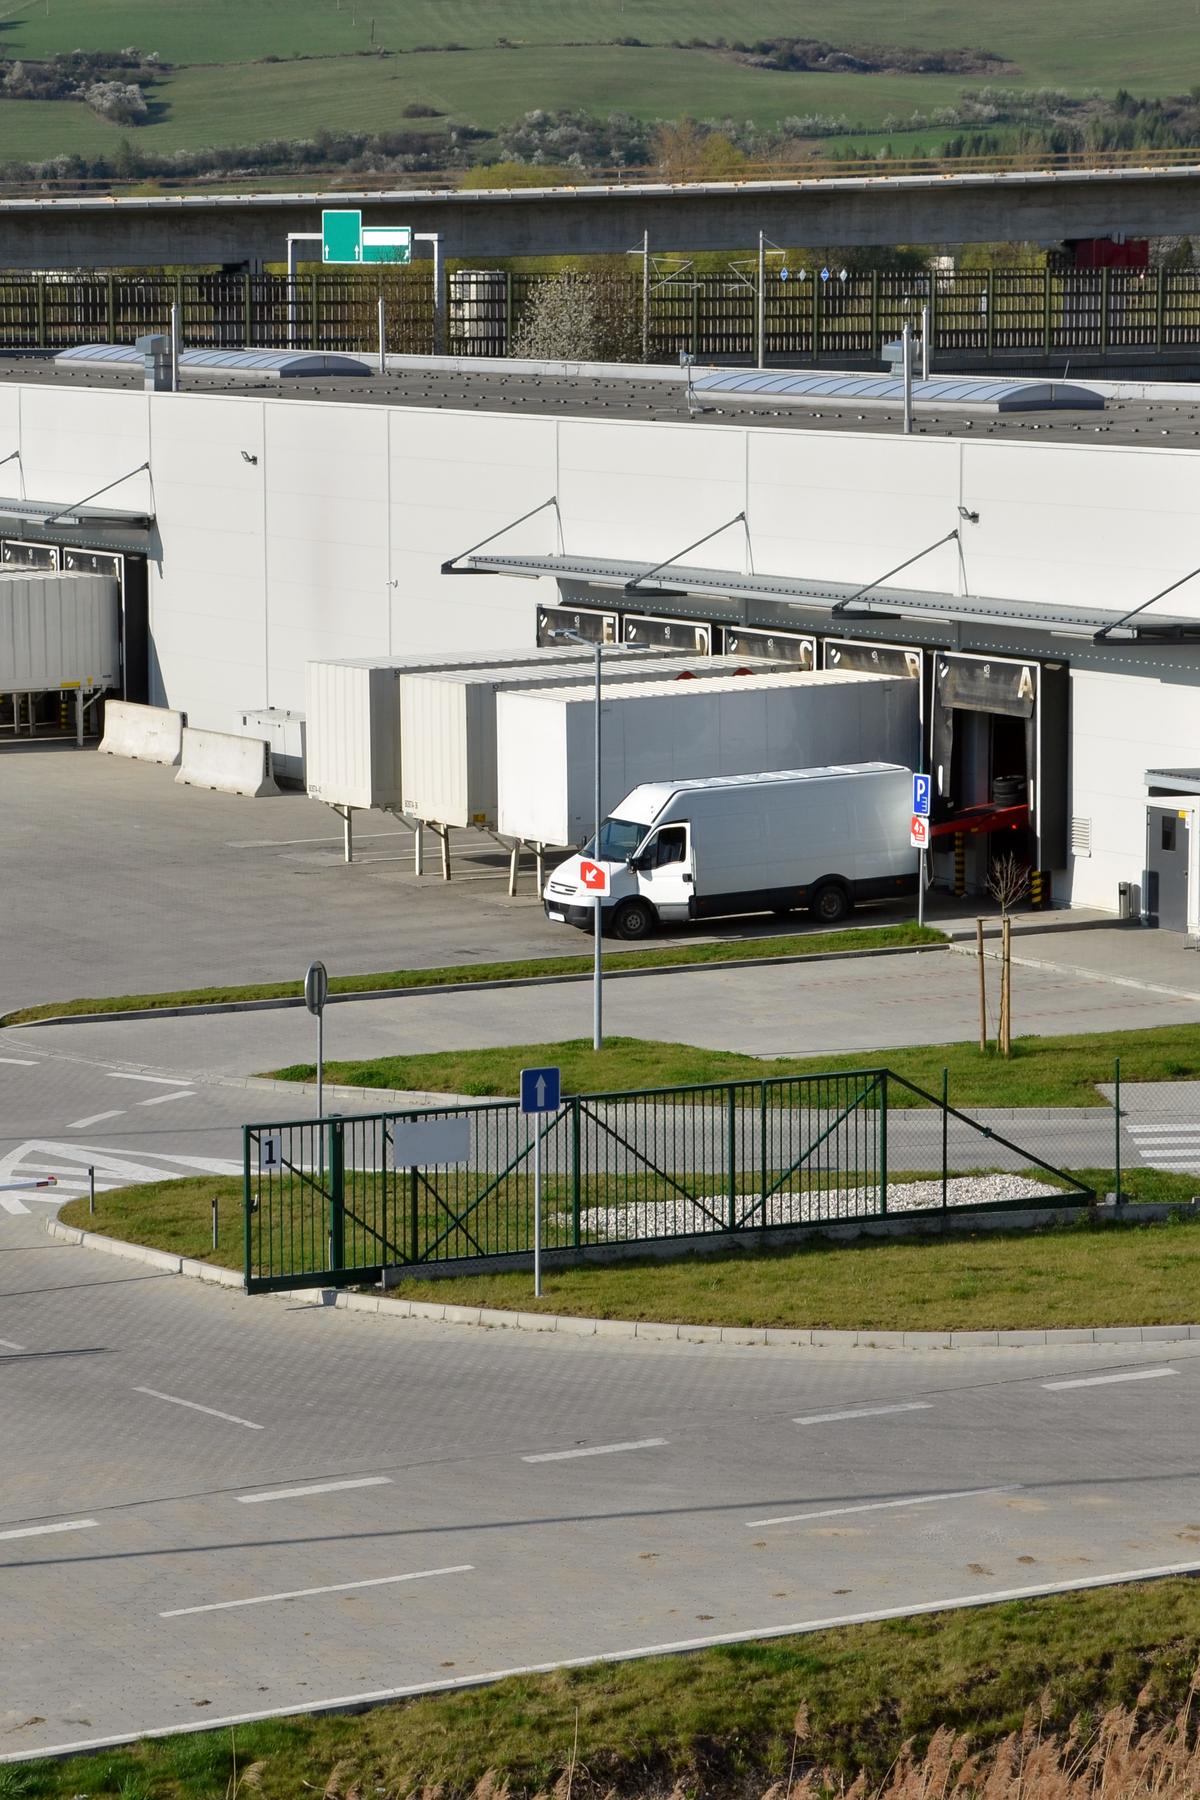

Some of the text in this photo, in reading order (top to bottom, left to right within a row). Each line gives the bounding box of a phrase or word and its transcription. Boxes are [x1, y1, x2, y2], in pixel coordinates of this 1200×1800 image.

[603, 616, 614, 644] E
[1018, 666, 1034, 699] A
[917, 779, 926, 802] P
[264, 1139, 277, 1164] 1
